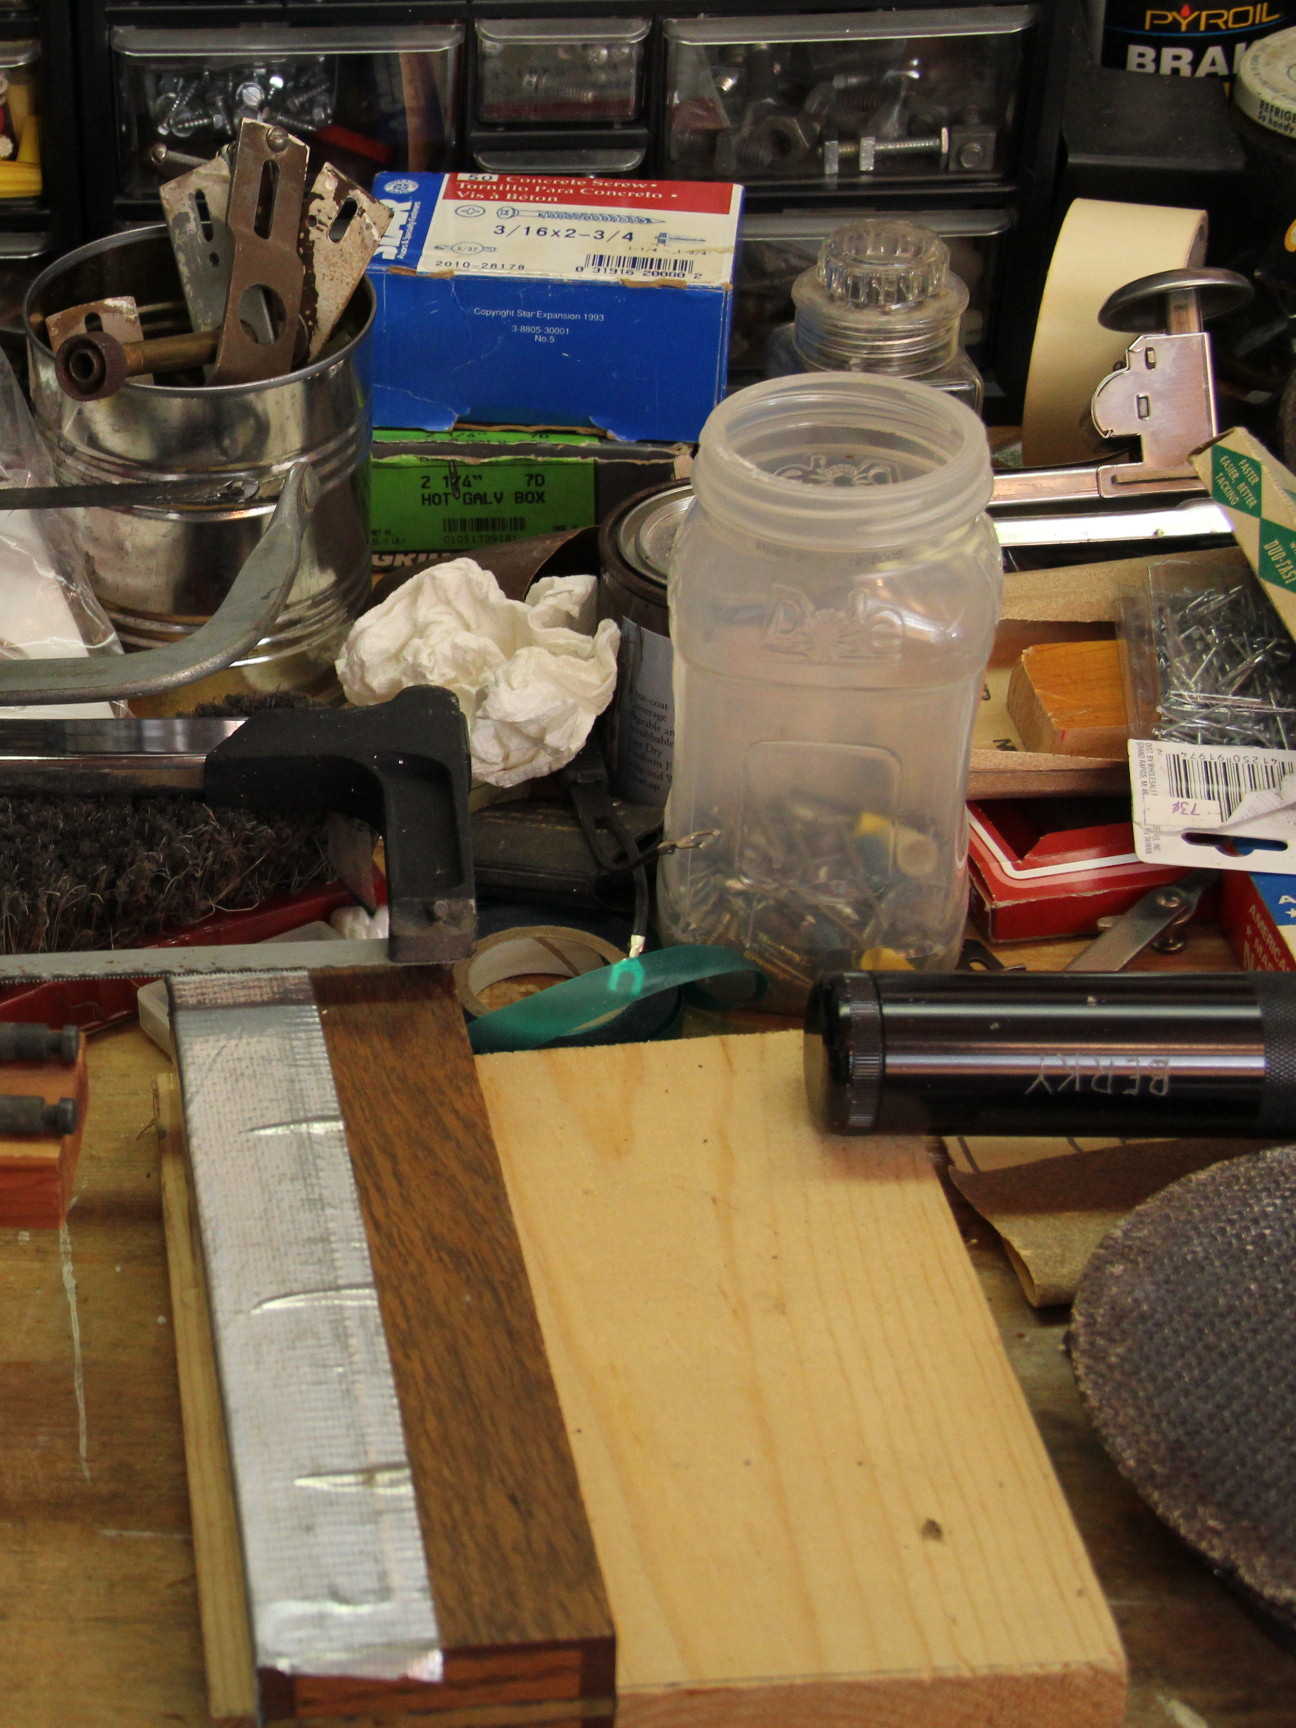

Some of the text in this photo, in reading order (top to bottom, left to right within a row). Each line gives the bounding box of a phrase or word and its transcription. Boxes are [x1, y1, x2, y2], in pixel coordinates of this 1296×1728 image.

[1145, 2, 1280, 31] PYROIL
[505, 175, 587, 187] Concrete
[455, 191, 558, 202] Vis à Béton
[456, 183, 662, 199] Tornillo Para Concreto
[493, 225, 634, 242] 3/16x2-3/4
[474, 308, 604, 321] Copyright Star Expansion 1993
[1238, 458, 1260, 486] FASTER
[420, 476, 430, 489] 2
[524, 473, 545, 487] 7D
[1215, 472, 1239, 506] TACKING
[1219, 455, 1257, 509] EASIER, BETTER
[421, 491, 546, 506] HOT GALV BOX
[1264, 539, 1296, 584] DUO-FAST
[635, 690, 668, 711] ne-coat
[646, 743, 663, 758] Dry
[1024, 1052, 1170, 1096] BERKY
